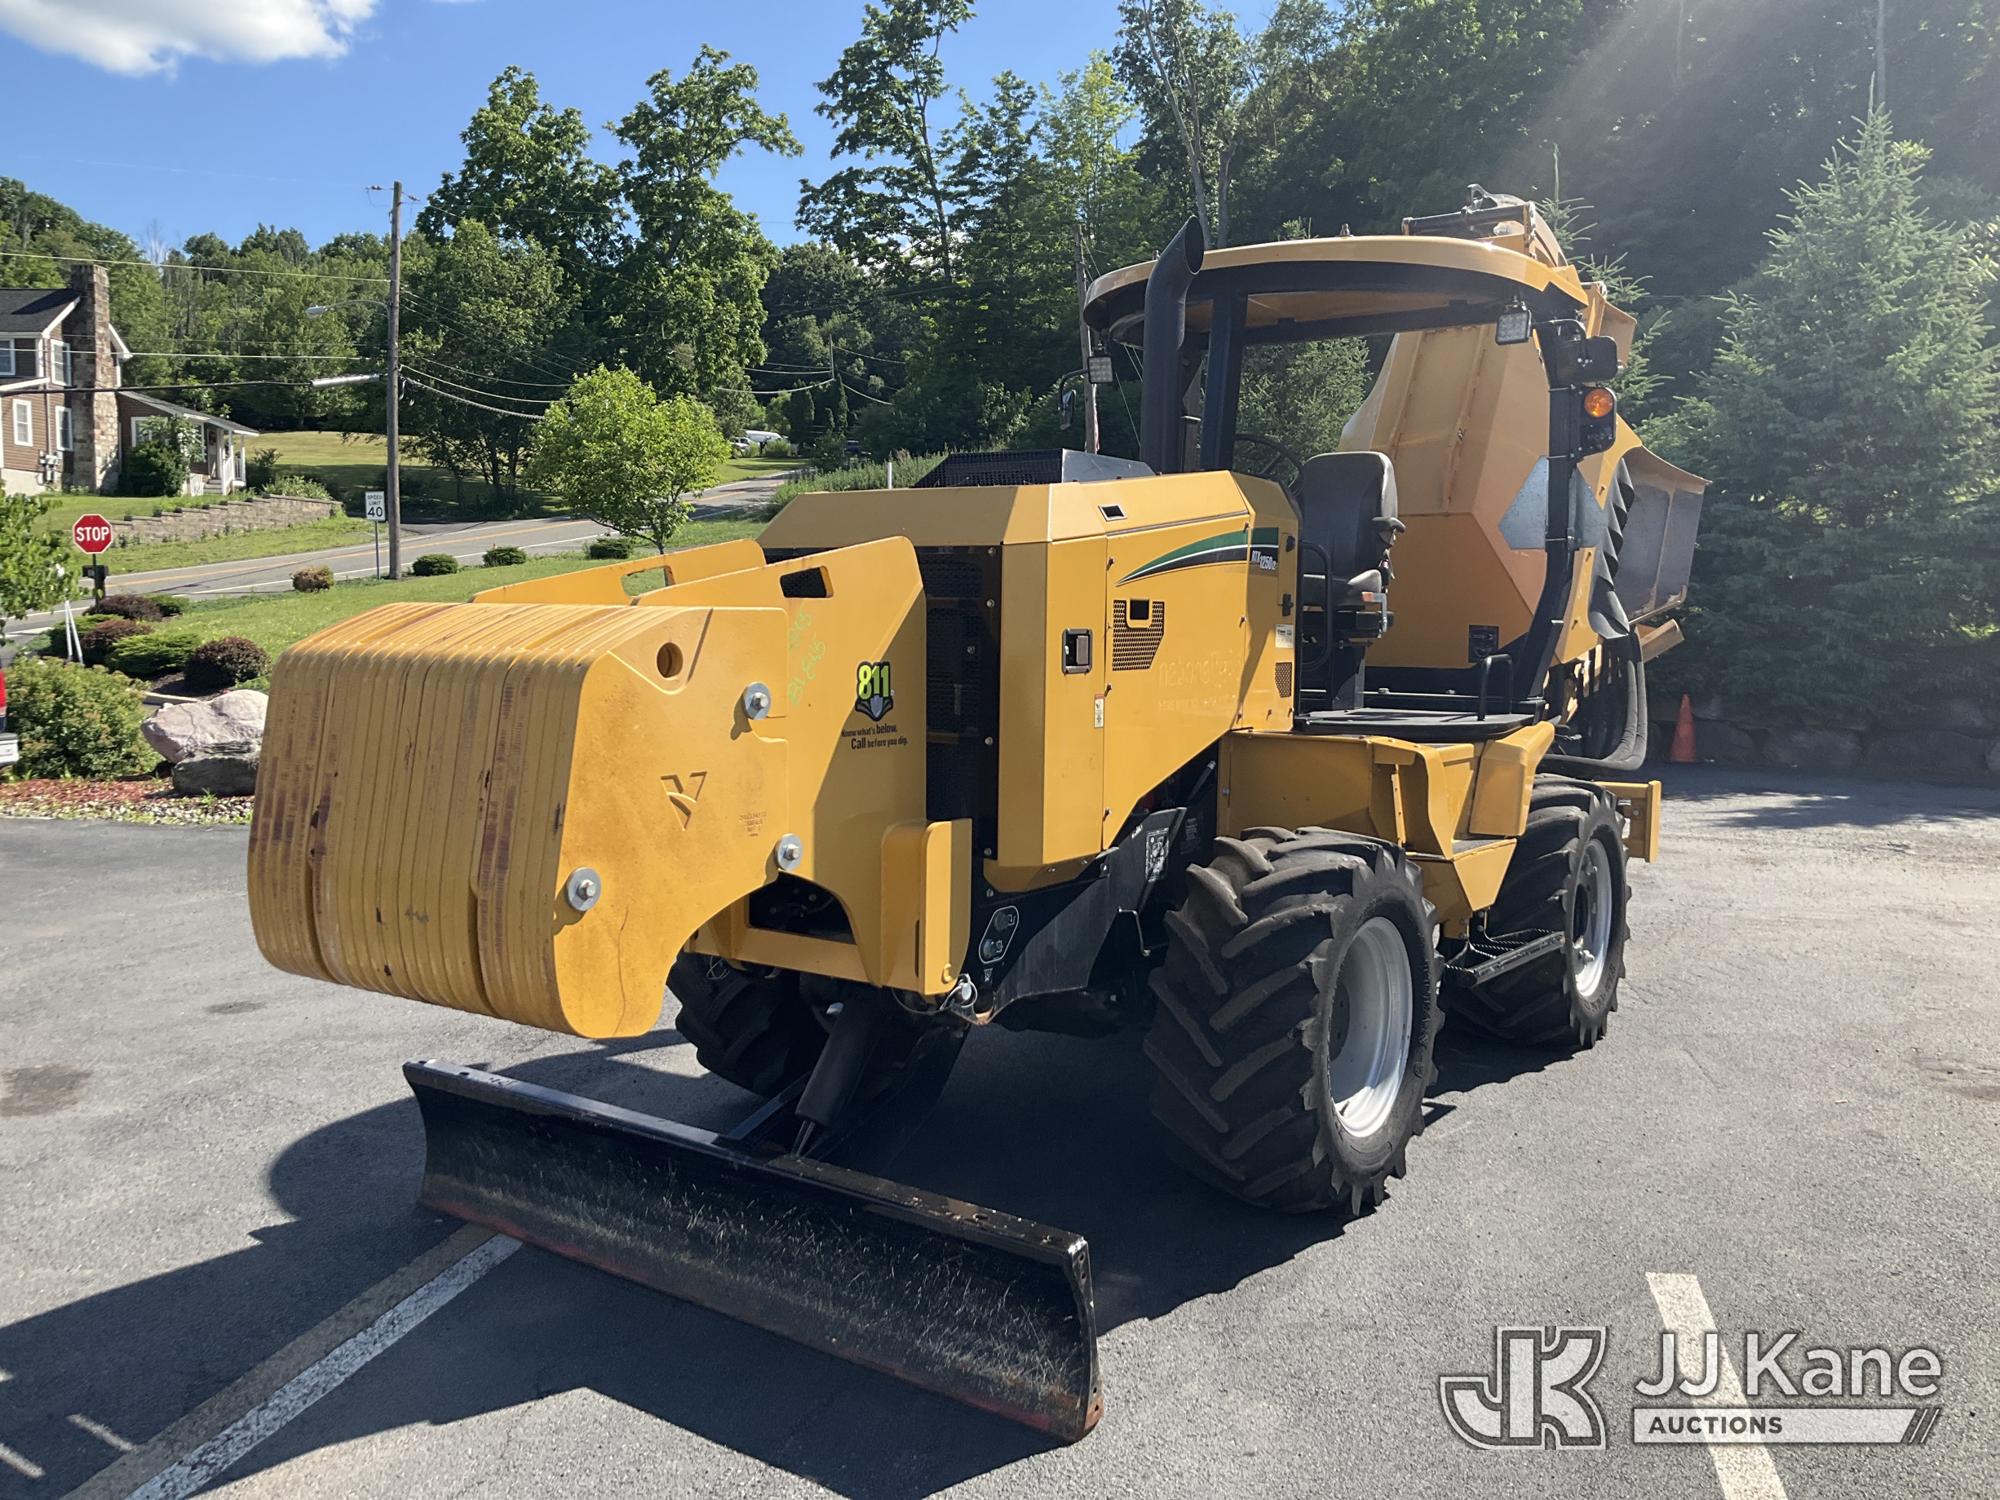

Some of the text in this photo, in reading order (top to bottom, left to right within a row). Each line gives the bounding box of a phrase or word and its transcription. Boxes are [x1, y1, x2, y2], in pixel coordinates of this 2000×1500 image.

[367, 506, 383, 517] 40
[76, 526, 110, 542] STOP
[857, 661, 891, 700] 811
[851, 737, 867, 750] Call
[867, 738, 887, 748] before
[887, 738, 898, 748] you
